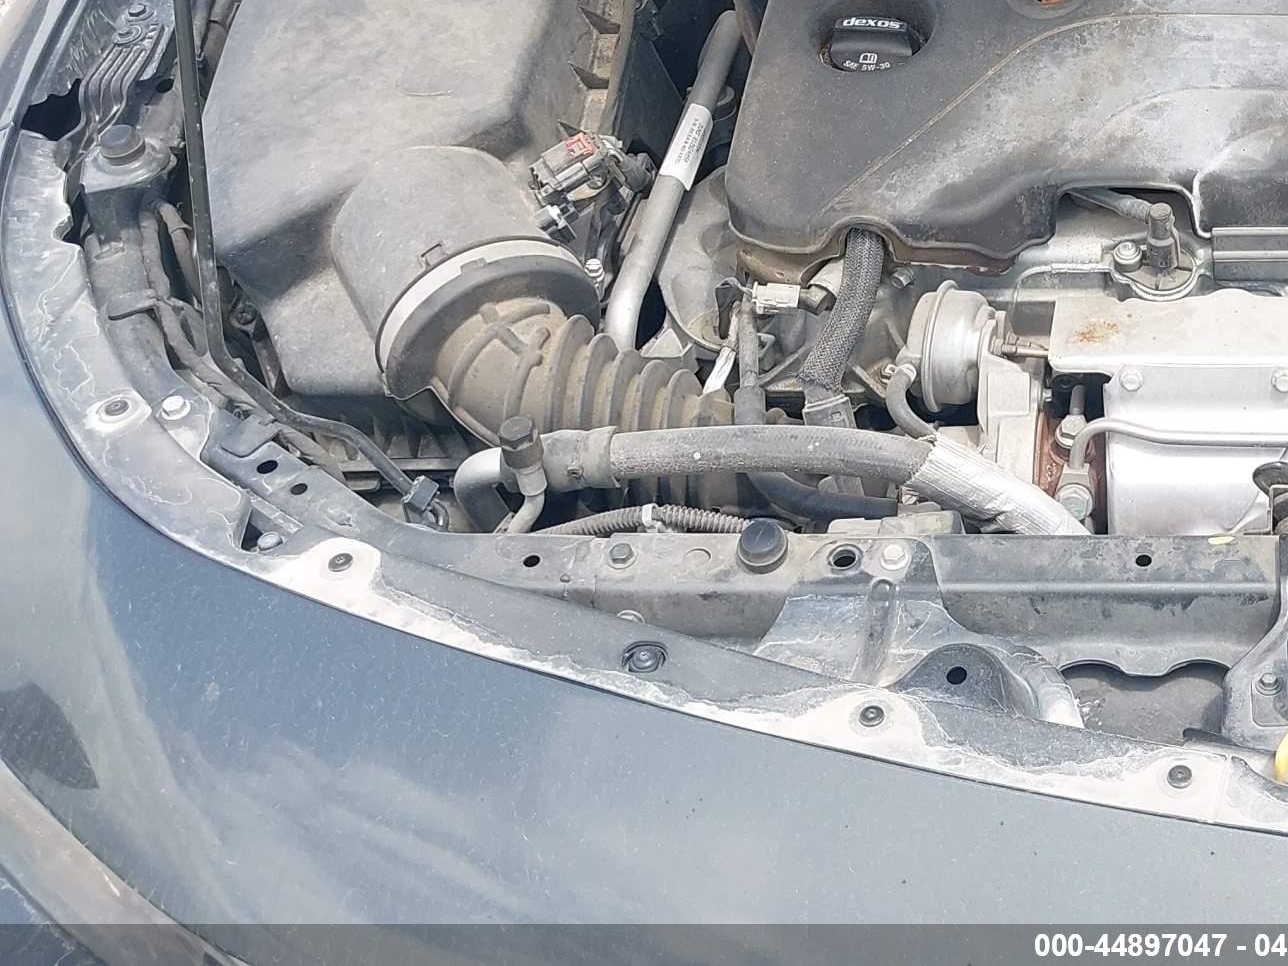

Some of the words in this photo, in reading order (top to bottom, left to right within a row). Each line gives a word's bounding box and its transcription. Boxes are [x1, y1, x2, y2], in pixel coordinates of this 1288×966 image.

[843, 17, 901, 29] dexos
[843, 59, 859, 71] SAE
[861, 61, 891, 71] 5W-30
